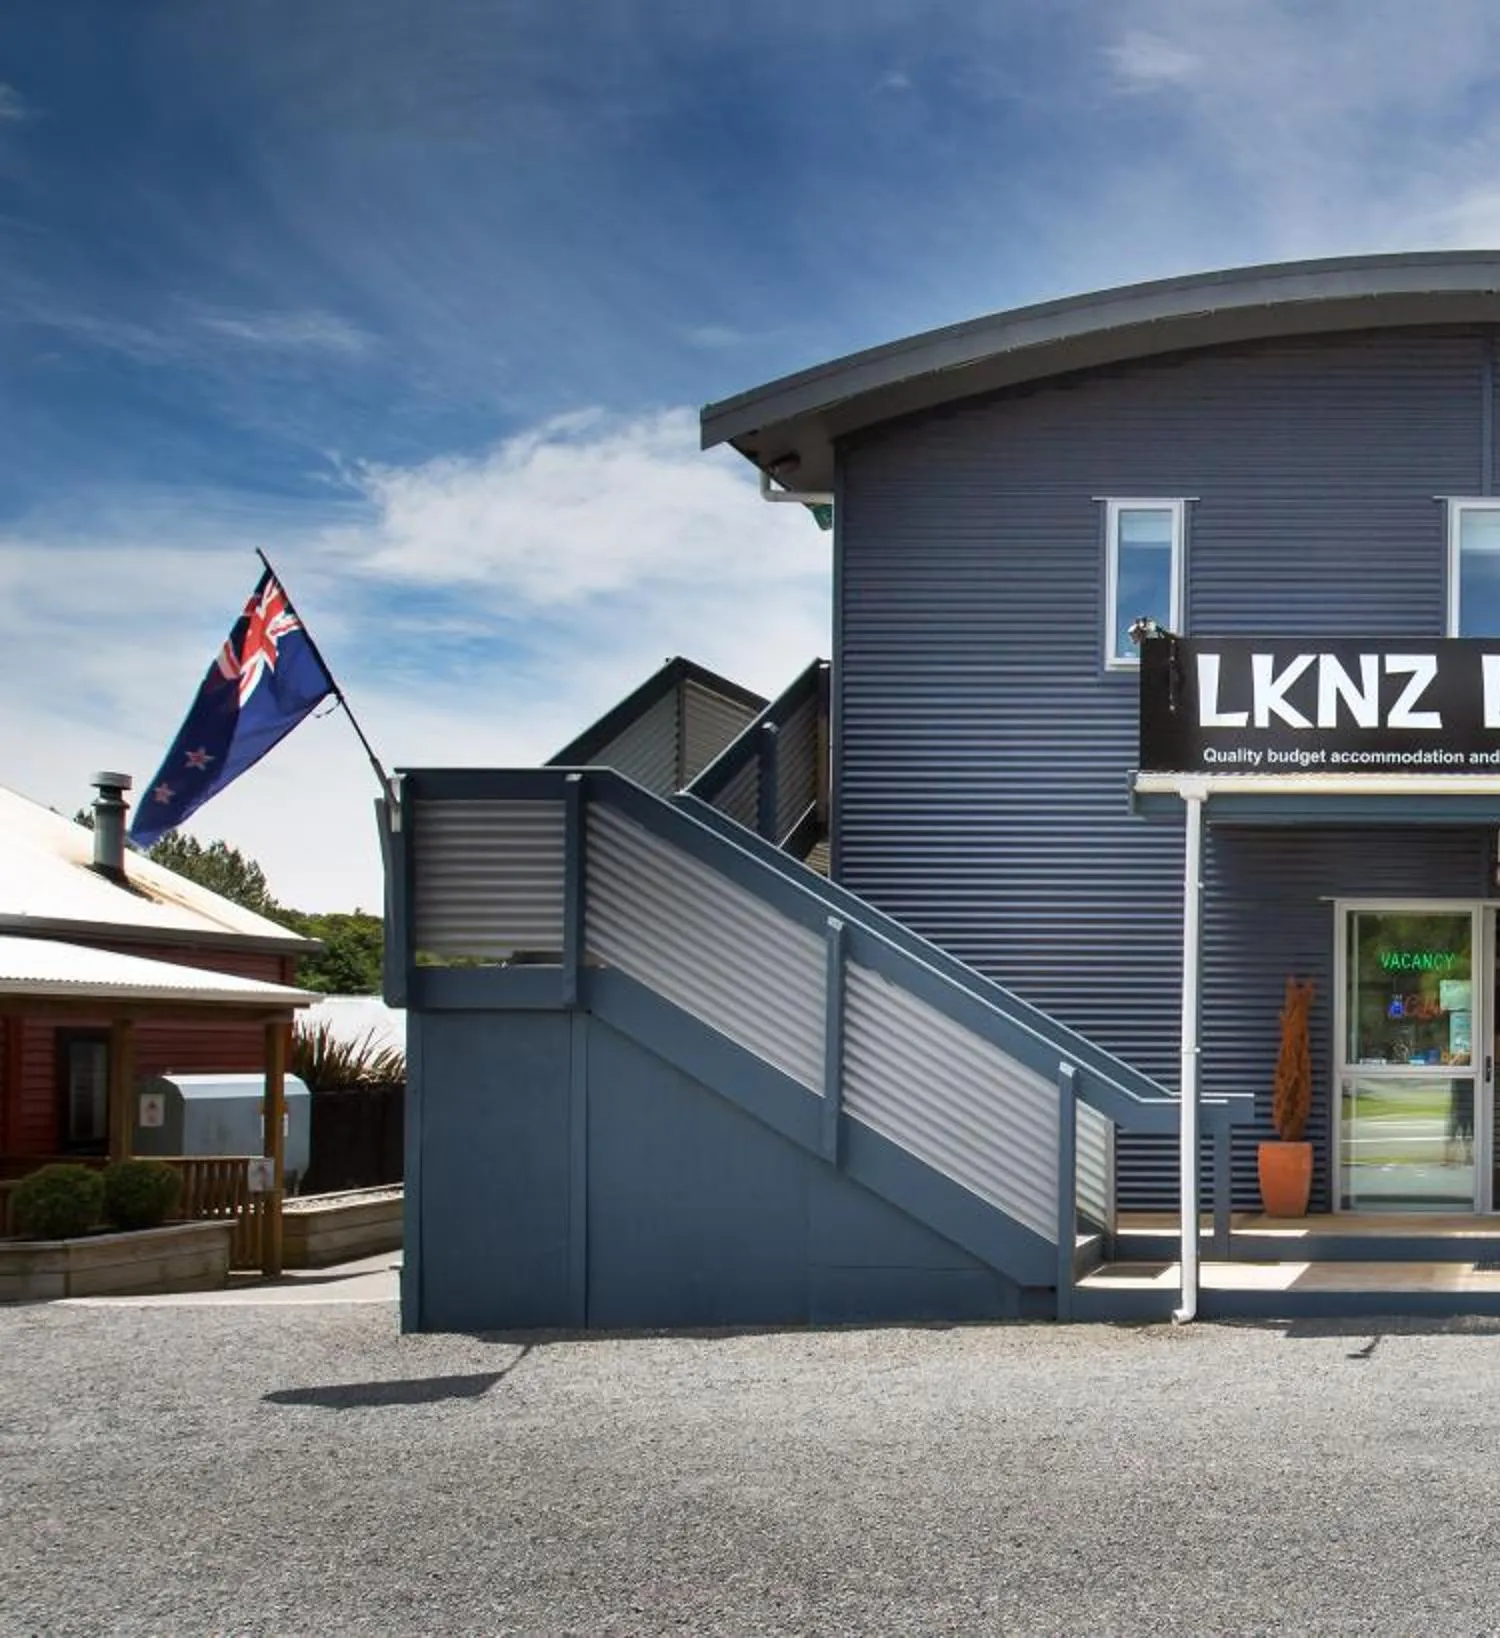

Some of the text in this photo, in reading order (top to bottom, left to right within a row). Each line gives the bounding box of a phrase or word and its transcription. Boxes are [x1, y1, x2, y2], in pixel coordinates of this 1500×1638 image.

[1196, 653, 1442, 729] LKNZ
[1203, 748, 1262, 766] Quality
[1267, 748, 1326, 766] budget
[1330, 749, 1465, 764] accommodation
[1469, 750, 1500, 764] and
[1381, 951, 1455, 970] VACANCY
